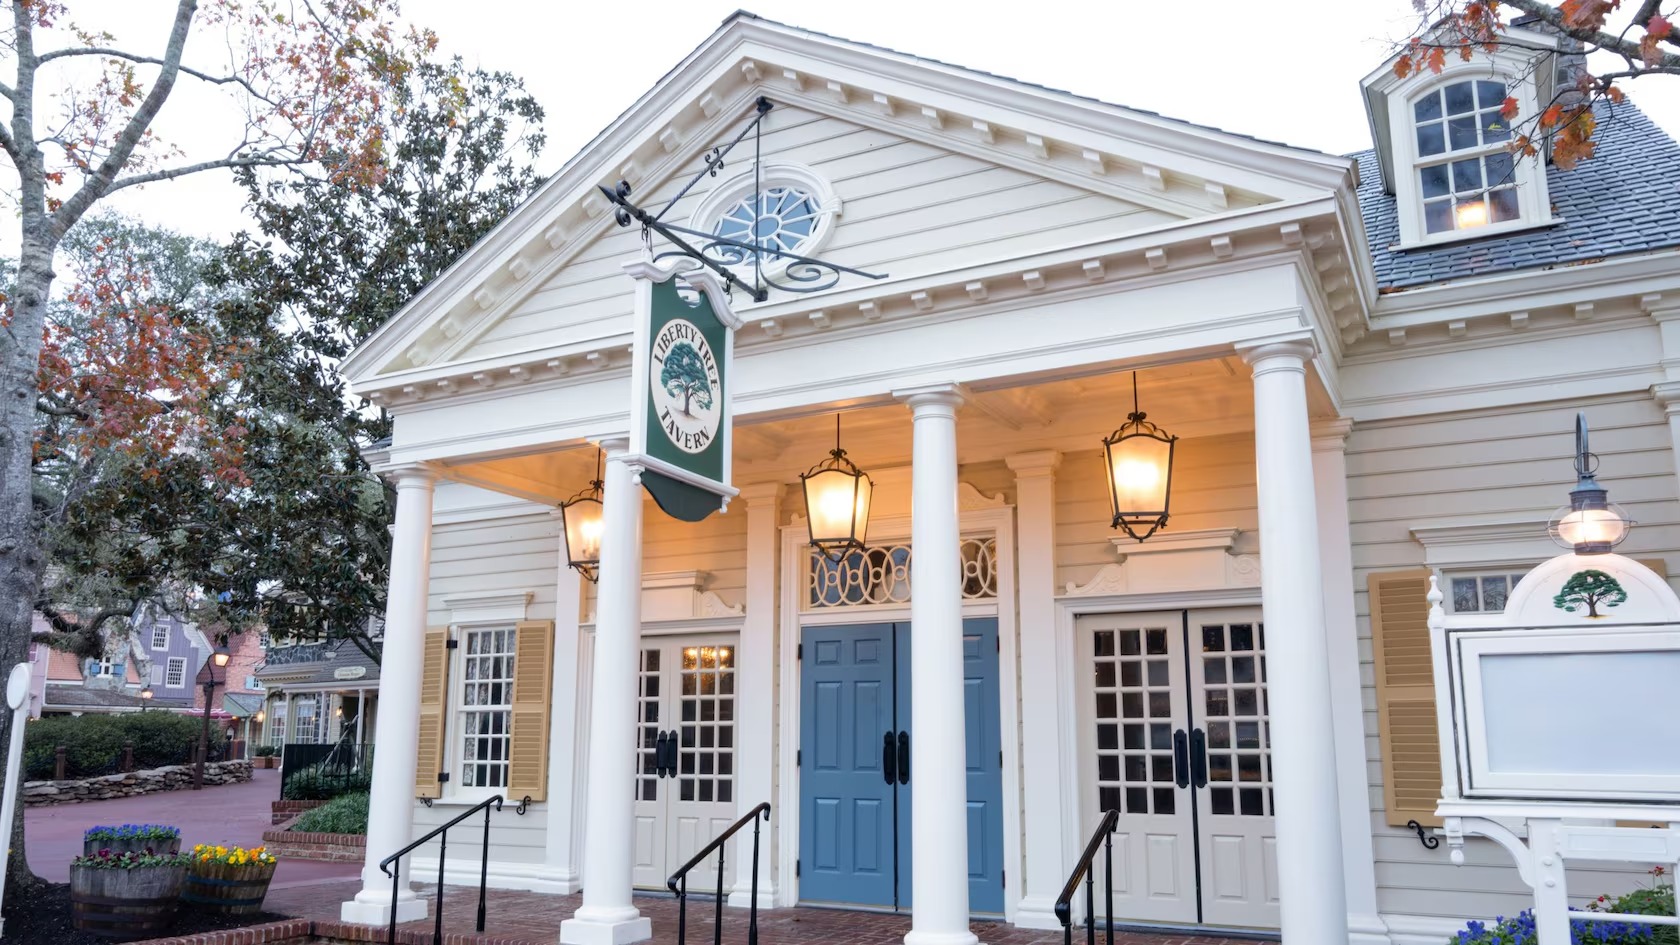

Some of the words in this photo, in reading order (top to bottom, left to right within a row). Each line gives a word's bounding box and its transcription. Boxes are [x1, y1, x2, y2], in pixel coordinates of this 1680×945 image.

[654, 323, 698, 365] LIBERTY
[698, 336, 719, 391] TREE
[660, 405, 711, 450] TAVERN
